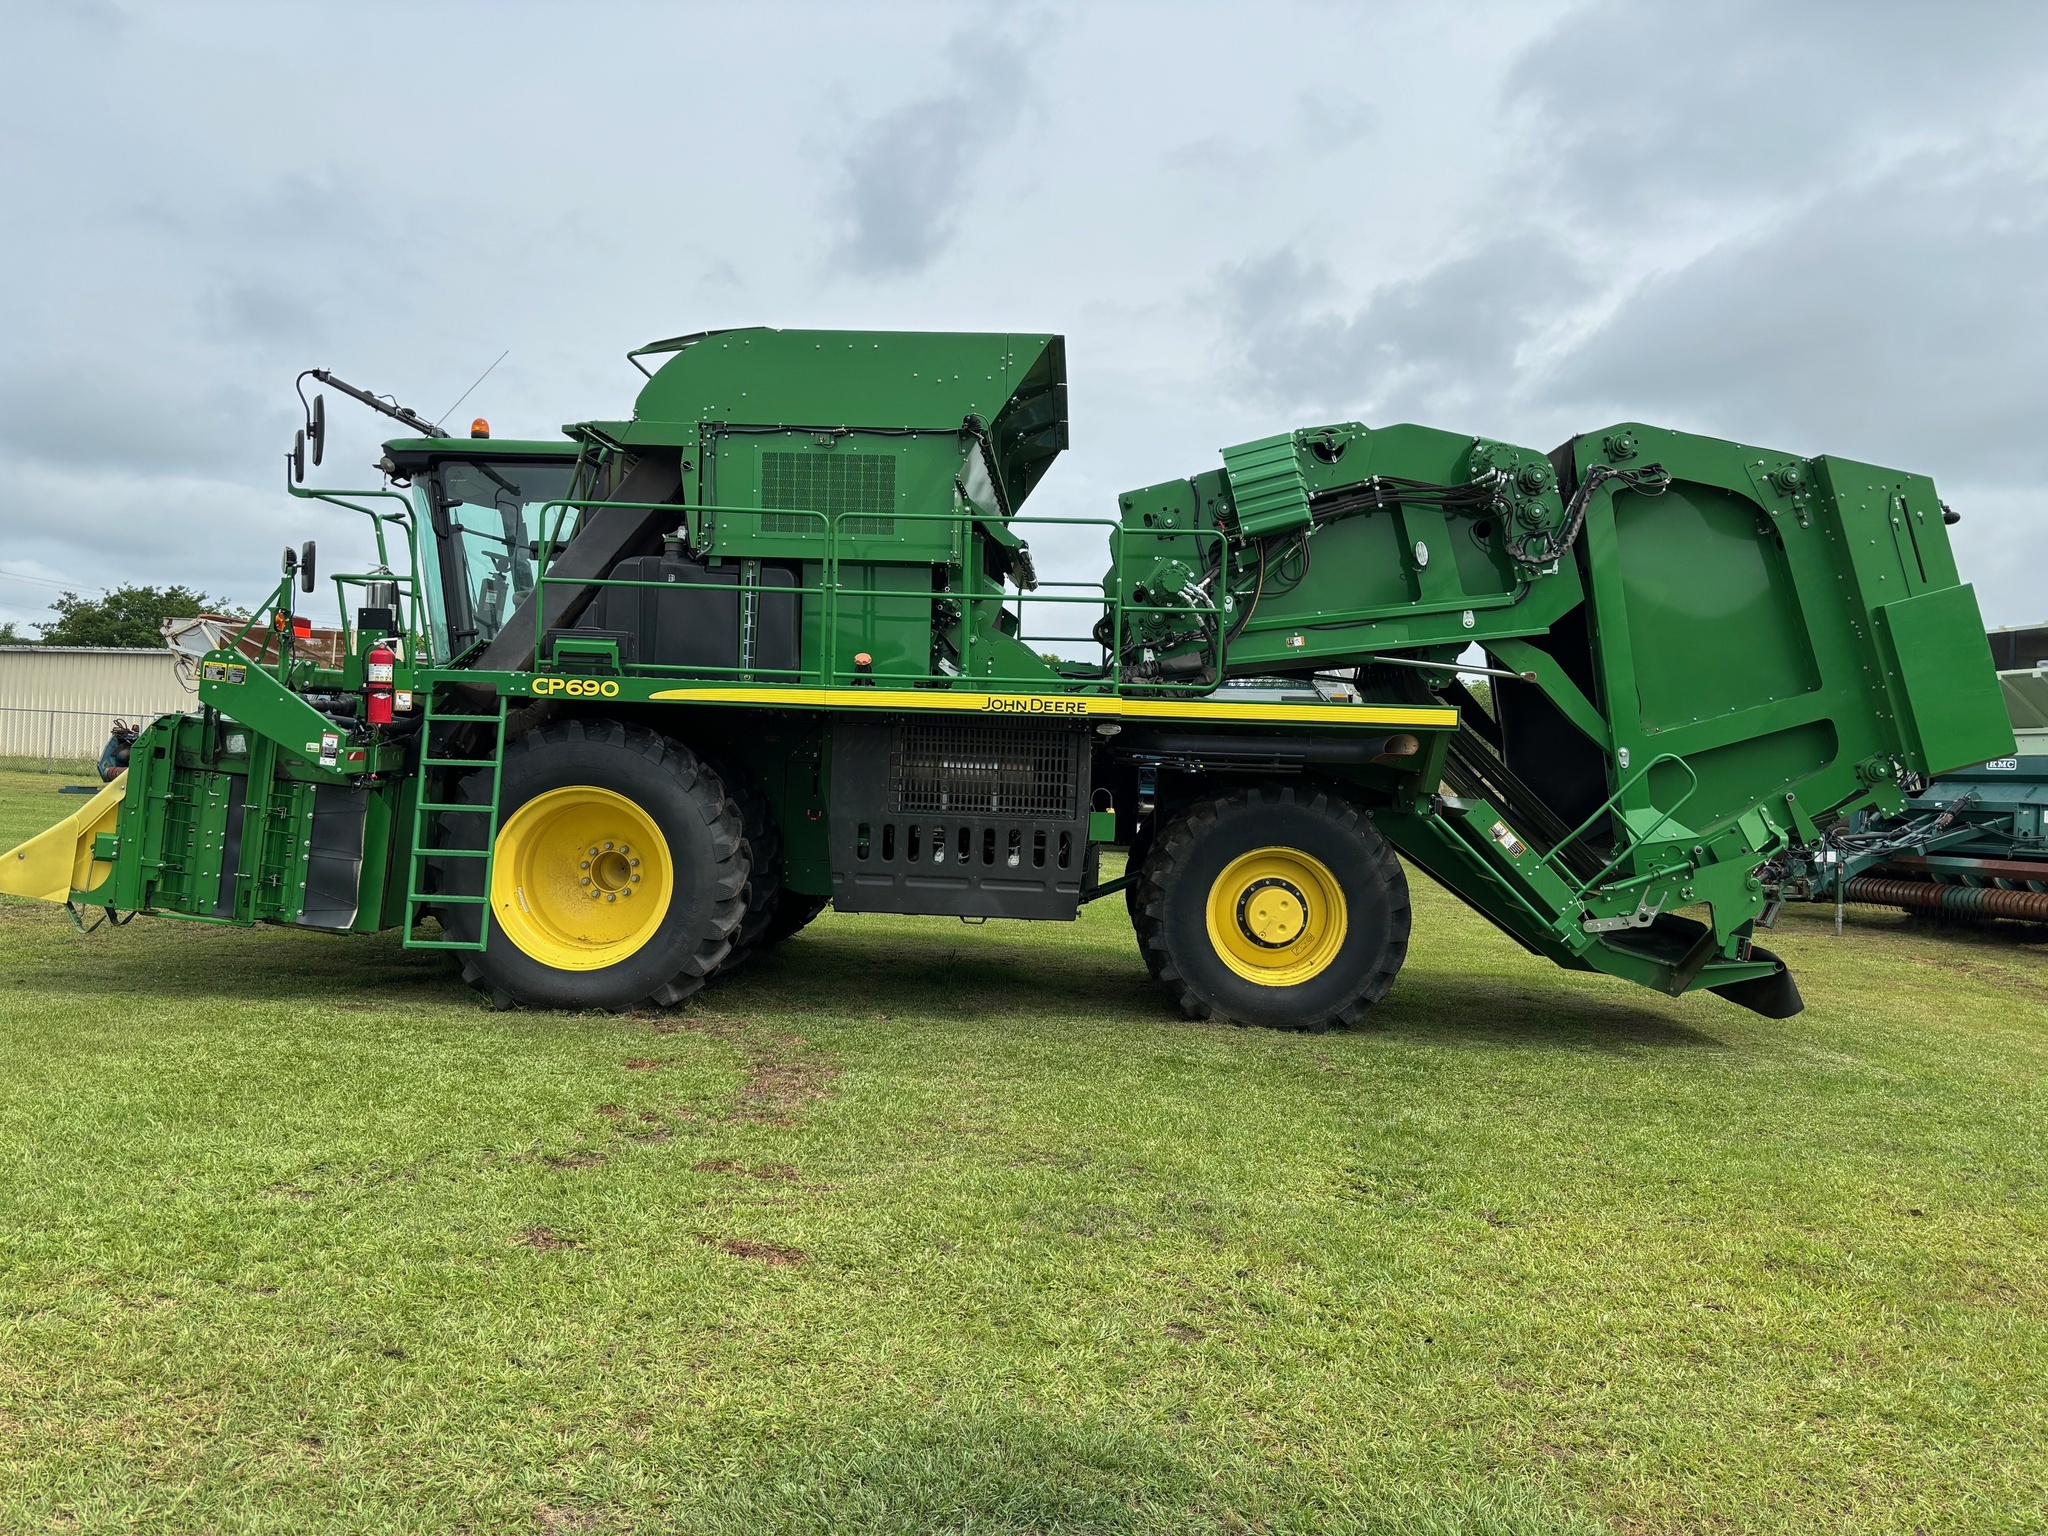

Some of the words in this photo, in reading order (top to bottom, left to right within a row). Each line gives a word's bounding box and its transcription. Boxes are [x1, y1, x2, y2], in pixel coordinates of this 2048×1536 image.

[531, 677, 620, 698] CP690
[981, 696, 1027, 711] JOHN
[1030, 698, 1087, 713] DEERE
